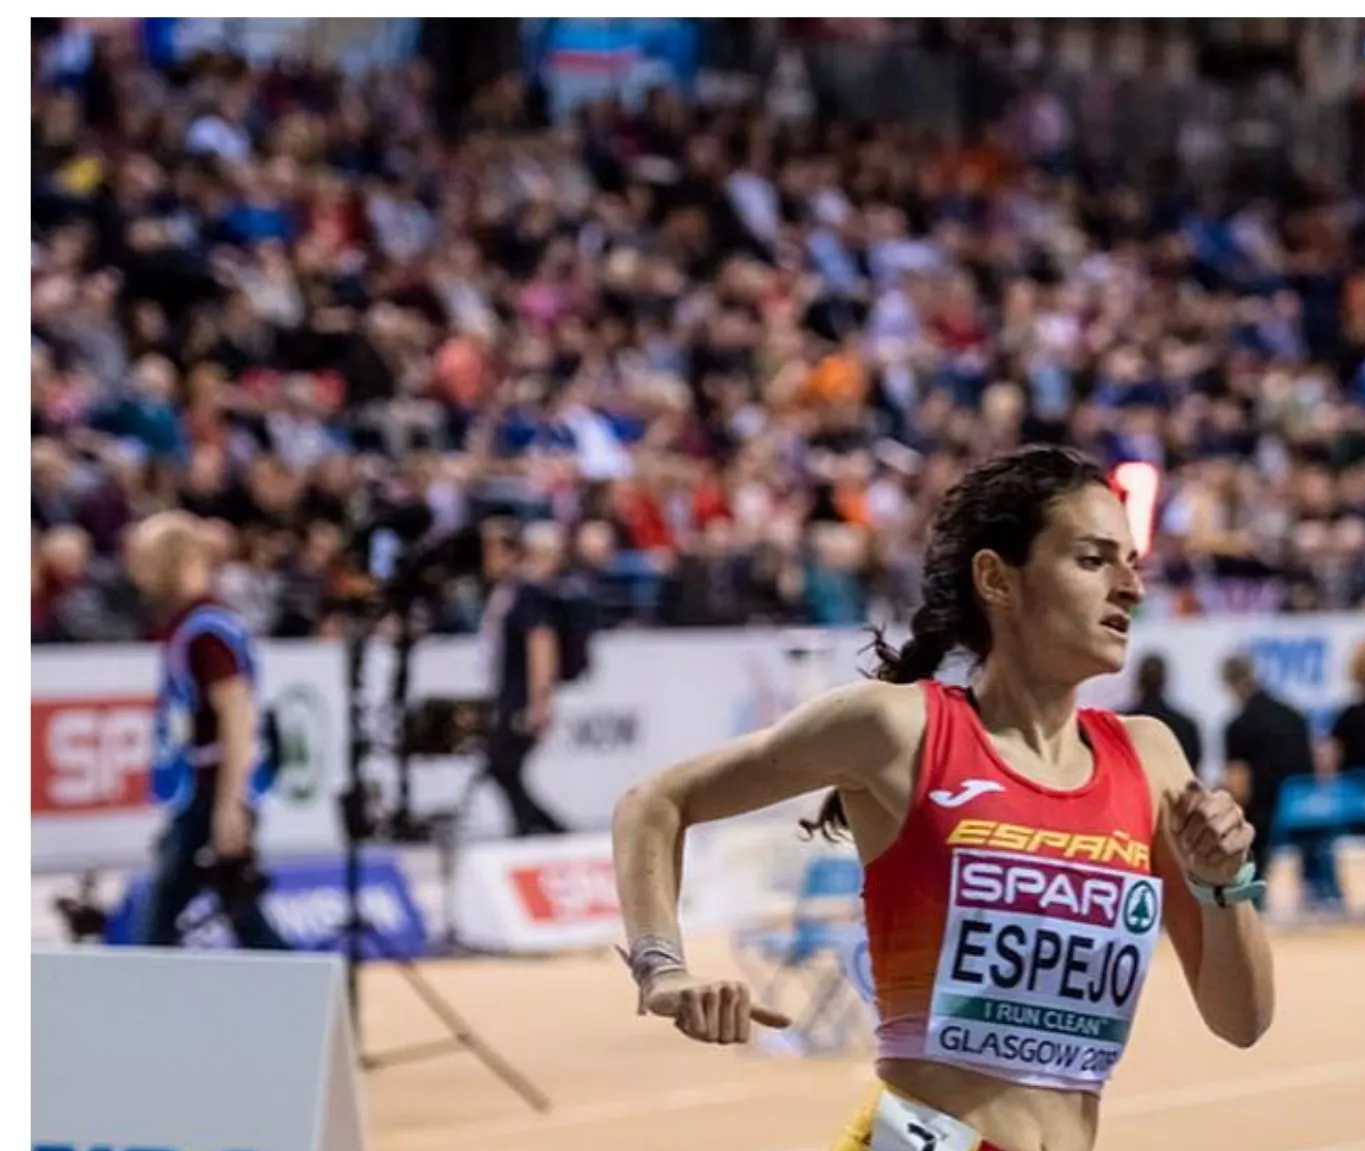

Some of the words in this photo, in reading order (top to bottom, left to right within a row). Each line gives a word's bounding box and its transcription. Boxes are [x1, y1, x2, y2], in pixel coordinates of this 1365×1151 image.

[960, 862, 1119, 920] SPAR
[951, 919, 1140, 1007] ESPEJO
[984, 1002, 992, 1018] I
[996, 1003, 1039, 1026] RUN
[1043, 1010, 1100, 1036] CLEAN
[939, 1025, 1080, 1067] GLASGOW
